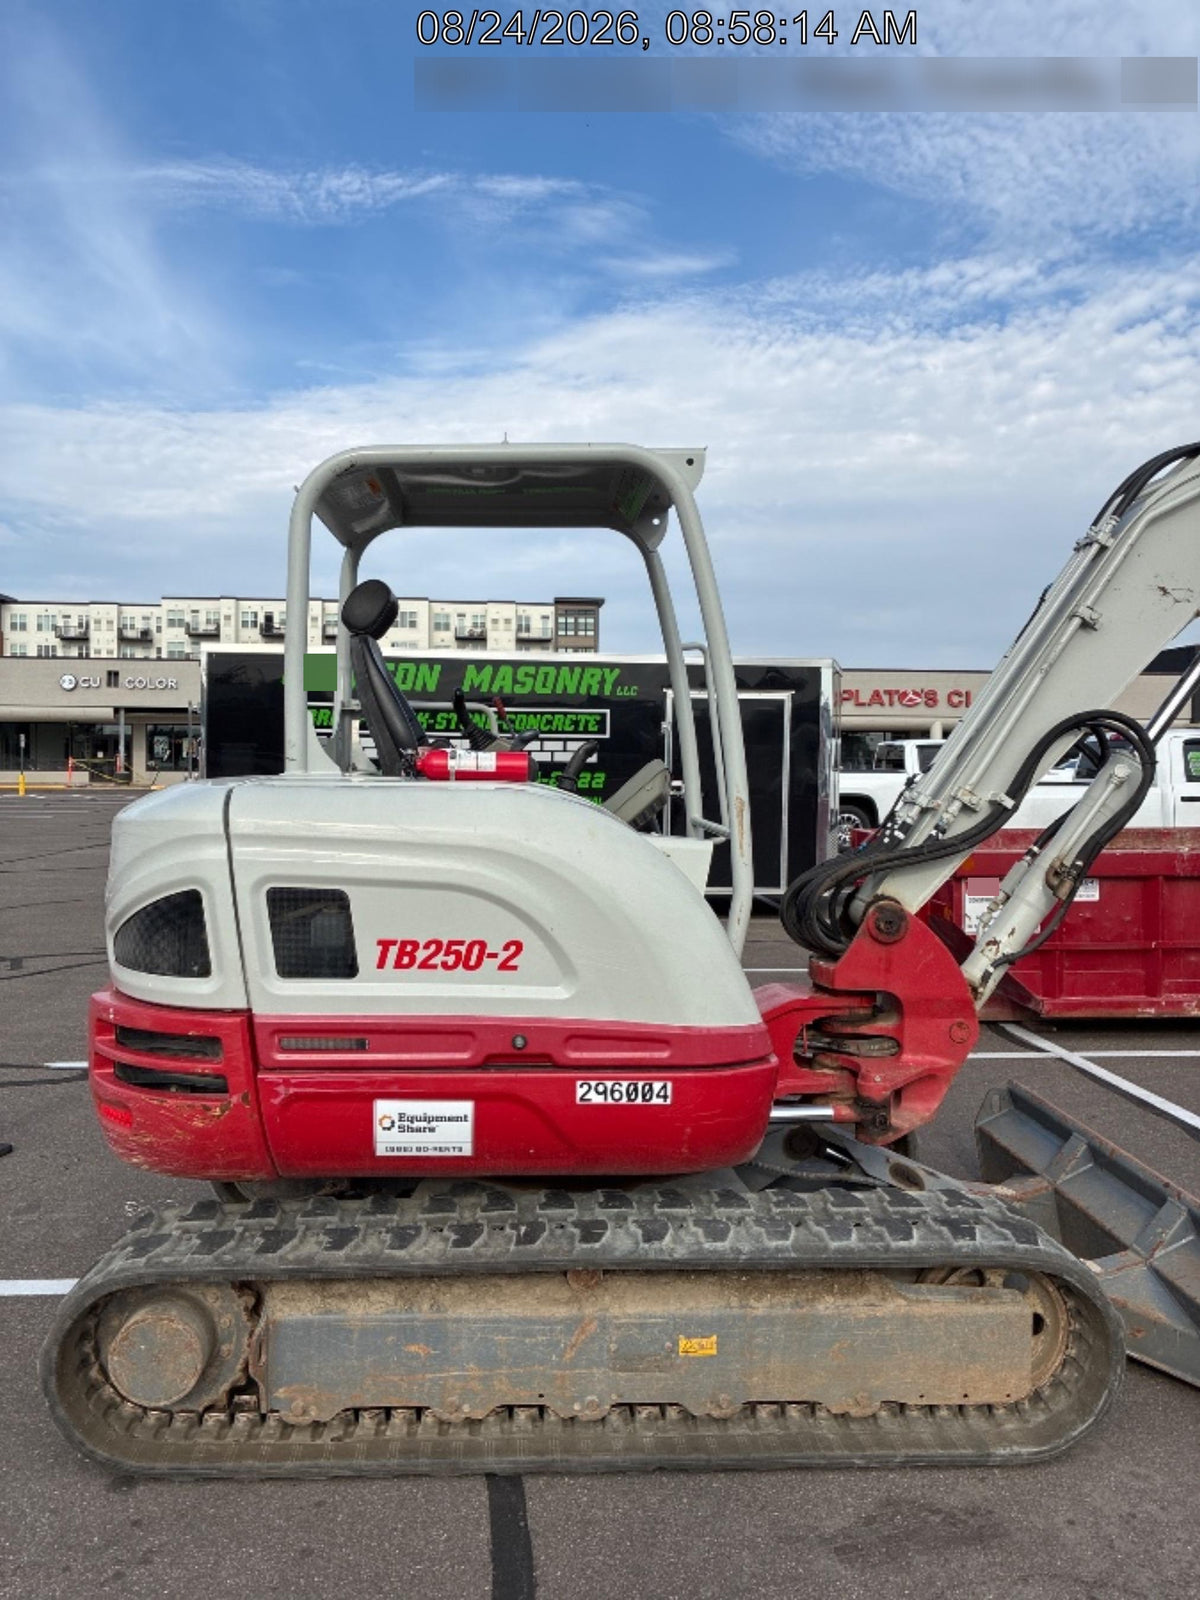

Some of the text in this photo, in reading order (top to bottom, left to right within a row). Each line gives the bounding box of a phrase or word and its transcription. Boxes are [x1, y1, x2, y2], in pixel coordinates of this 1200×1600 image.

[125, 676, 178, 689] COLOR
[462, 664, 621, 696] MASONRY
[616, 685, 639, 696] LLC
[376, 938, 524, 972] TB250-2
[579, 1081, 670, 1103] 296004
[397, 1112, 469, 1124] Equipment
[397, 1124, 436, 1133] Share
